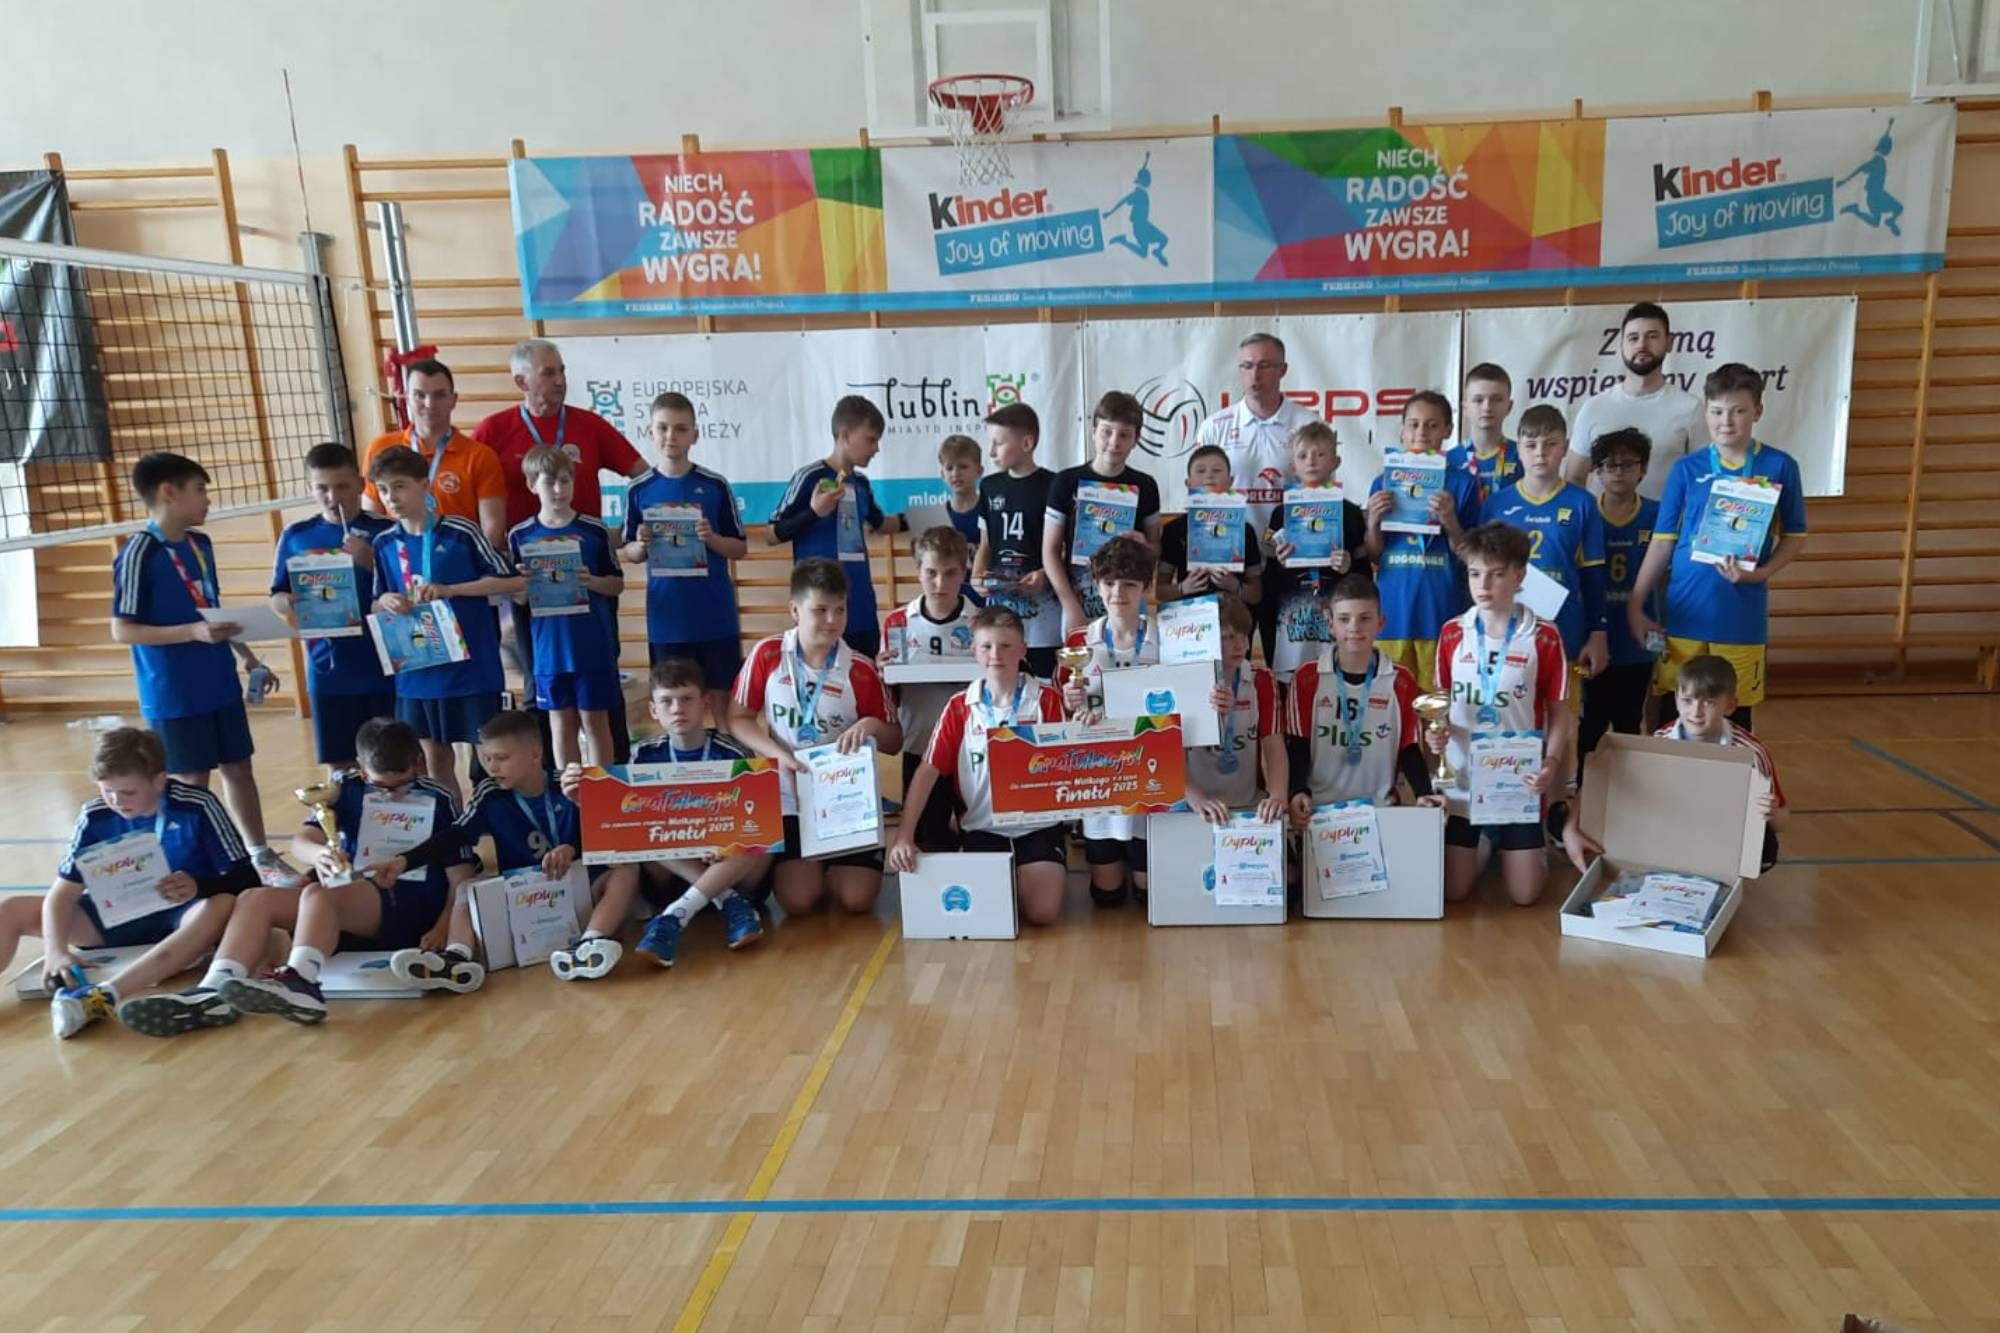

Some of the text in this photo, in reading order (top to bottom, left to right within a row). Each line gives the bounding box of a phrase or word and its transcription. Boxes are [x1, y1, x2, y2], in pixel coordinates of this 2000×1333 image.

[1377, 149, 1438, 169] NIECH
[664, 173, 723, 193] NIECH
[1346, 165, 1469, 203] RADOŚĆ
[638, 190, 755, 227] RADOŚĆ
[1364, 205, 1448, 228] ZAWSZE
[1664, 192, 1825, 238] Joy of moving
[659, 230, 738, 251] ZAWSZE
[944, 222, 1095, 266] Joy of moving
[1344, 229, 1470, 262] WYGRA!
[641, 253, 762, 284] WYGRA!
[1598, 328, 1716, 359] Z mą
[1000, 511, 1025, 541] 14
[1528, 529, 1544, 559] 2
[1610, 552, 1627, 583] 6
[929, 636, 942, 655] 9
